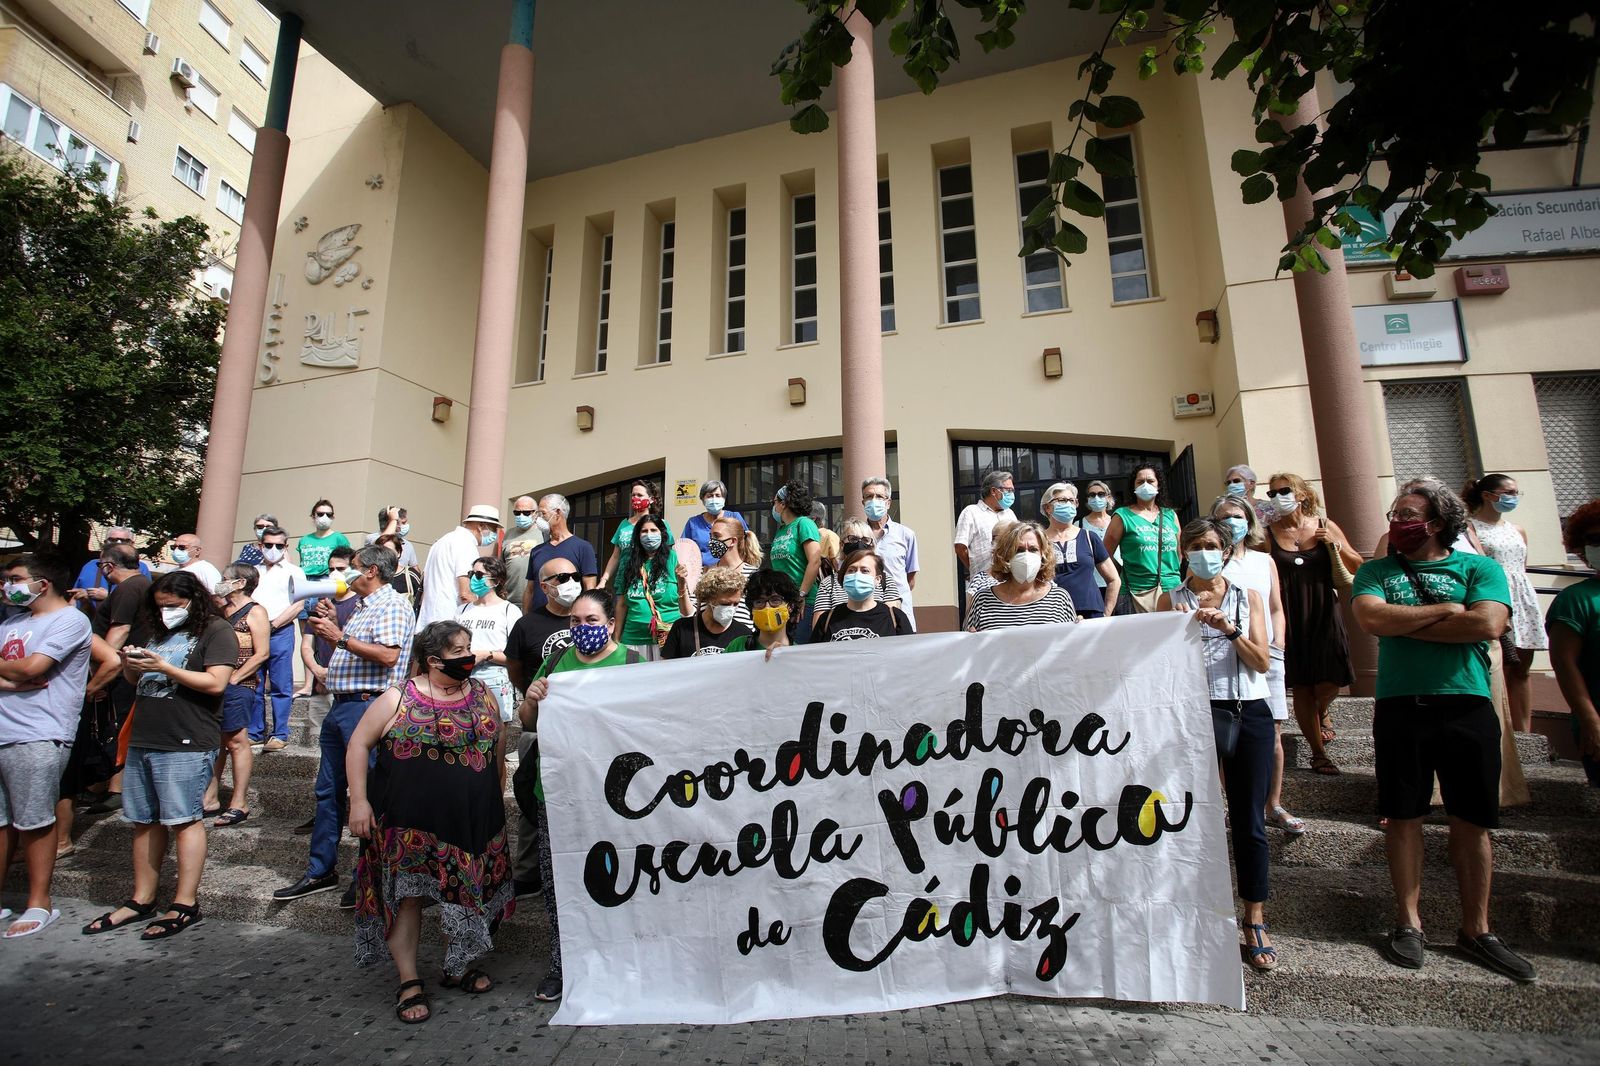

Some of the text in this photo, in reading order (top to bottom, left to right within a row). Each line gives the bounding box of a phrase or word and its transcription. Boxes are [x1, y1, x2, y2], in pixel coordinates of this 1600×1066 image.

[1494, 197, 1600, 218] ación Secundari
[1522, 226, 1600, 243] Rafael Albe
[1360, 338, 1443, 352] Centro bilingüe
[475, 620, 495, 630] PWR
[604, 682, 1130, 819] Coordinadora
[583, 768, 1193, 908] escuela Pública
[737, 863, 1081, 982] de Cádiz
